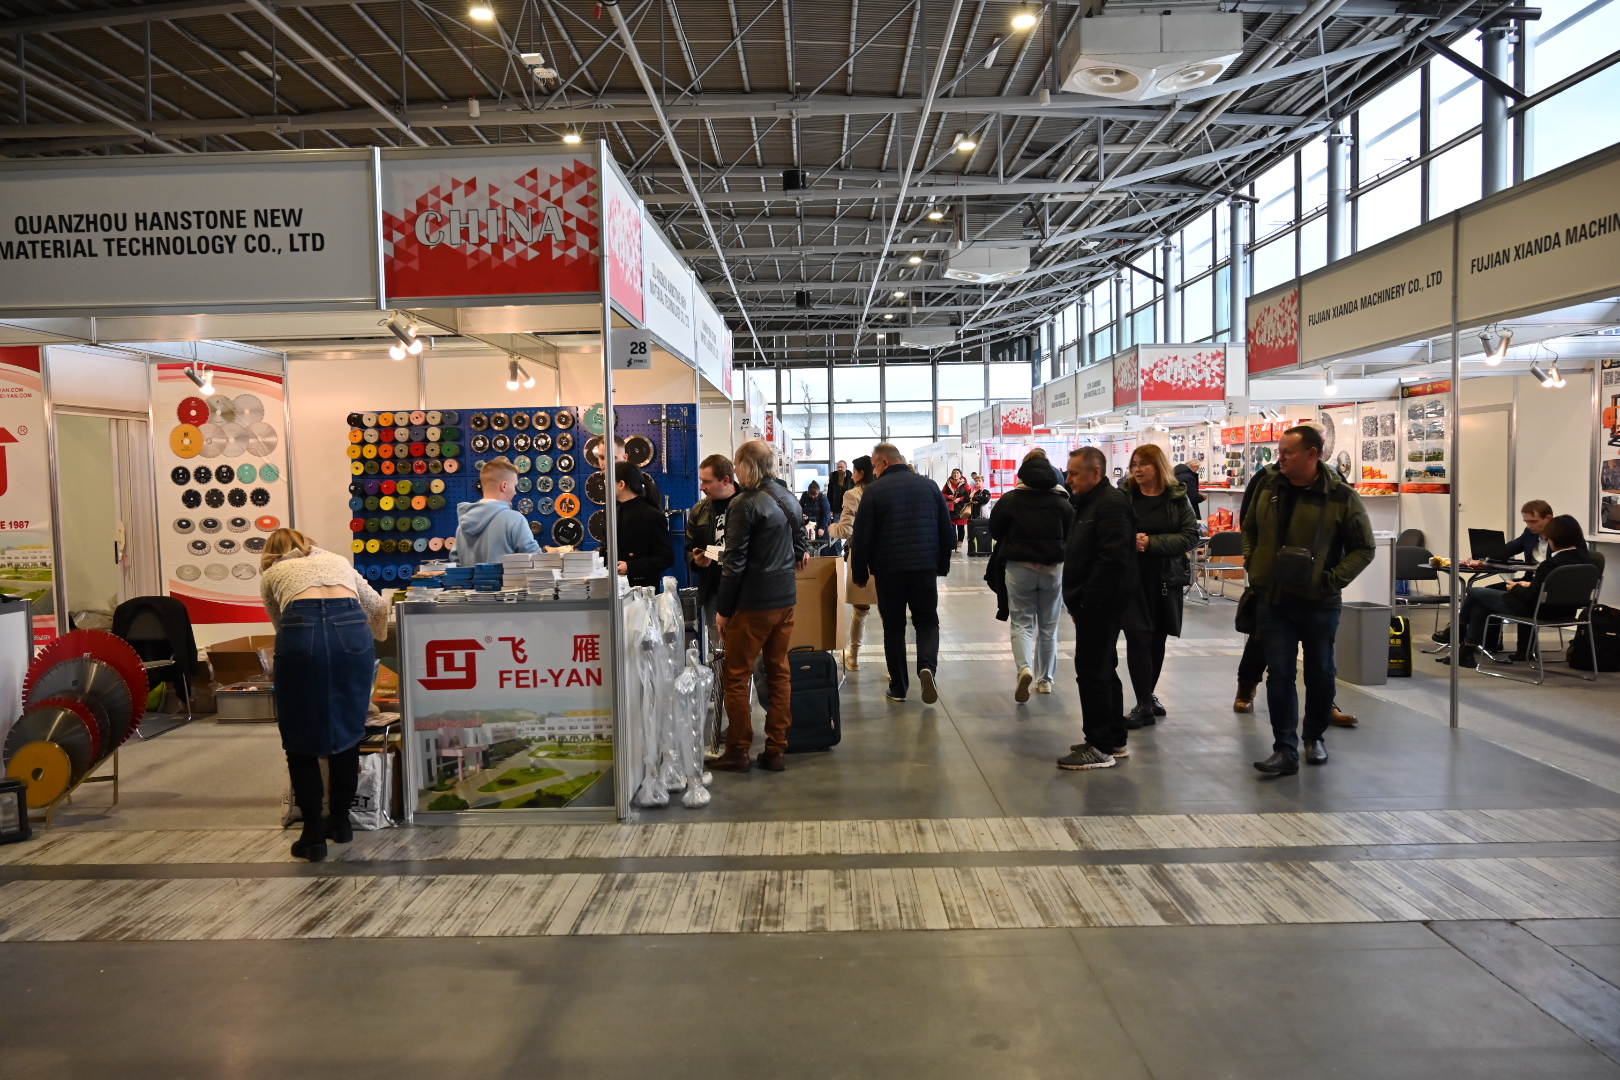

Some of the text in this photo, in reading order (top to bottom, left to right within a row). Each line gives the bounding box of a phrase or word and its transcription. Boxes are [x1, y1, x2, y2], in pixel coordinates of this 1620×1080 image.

[15, 207, 303, 235] QUANZHOU HANSTONE NEW
[414, 206, 567, 246] CHINA
[0, 231, 325, 260] MATERIAL TECHNOLOGY CO., LTD
[1470, 247, 1511, 274] FUJIAN
[1513, 231, 1561, 262] XIANDA
[1308, 270, 1443, 327] FUJIAN XIANDA MACHINERY CO., LTD
[1256, 316, 1292, 347] CHINA
[630, 341, 648, 355] 28
[1152, 366, 1212, 382] CHINA
[9, 520, 30, 530] 1987
[498, 667, 603, 689] FEI-YAN
